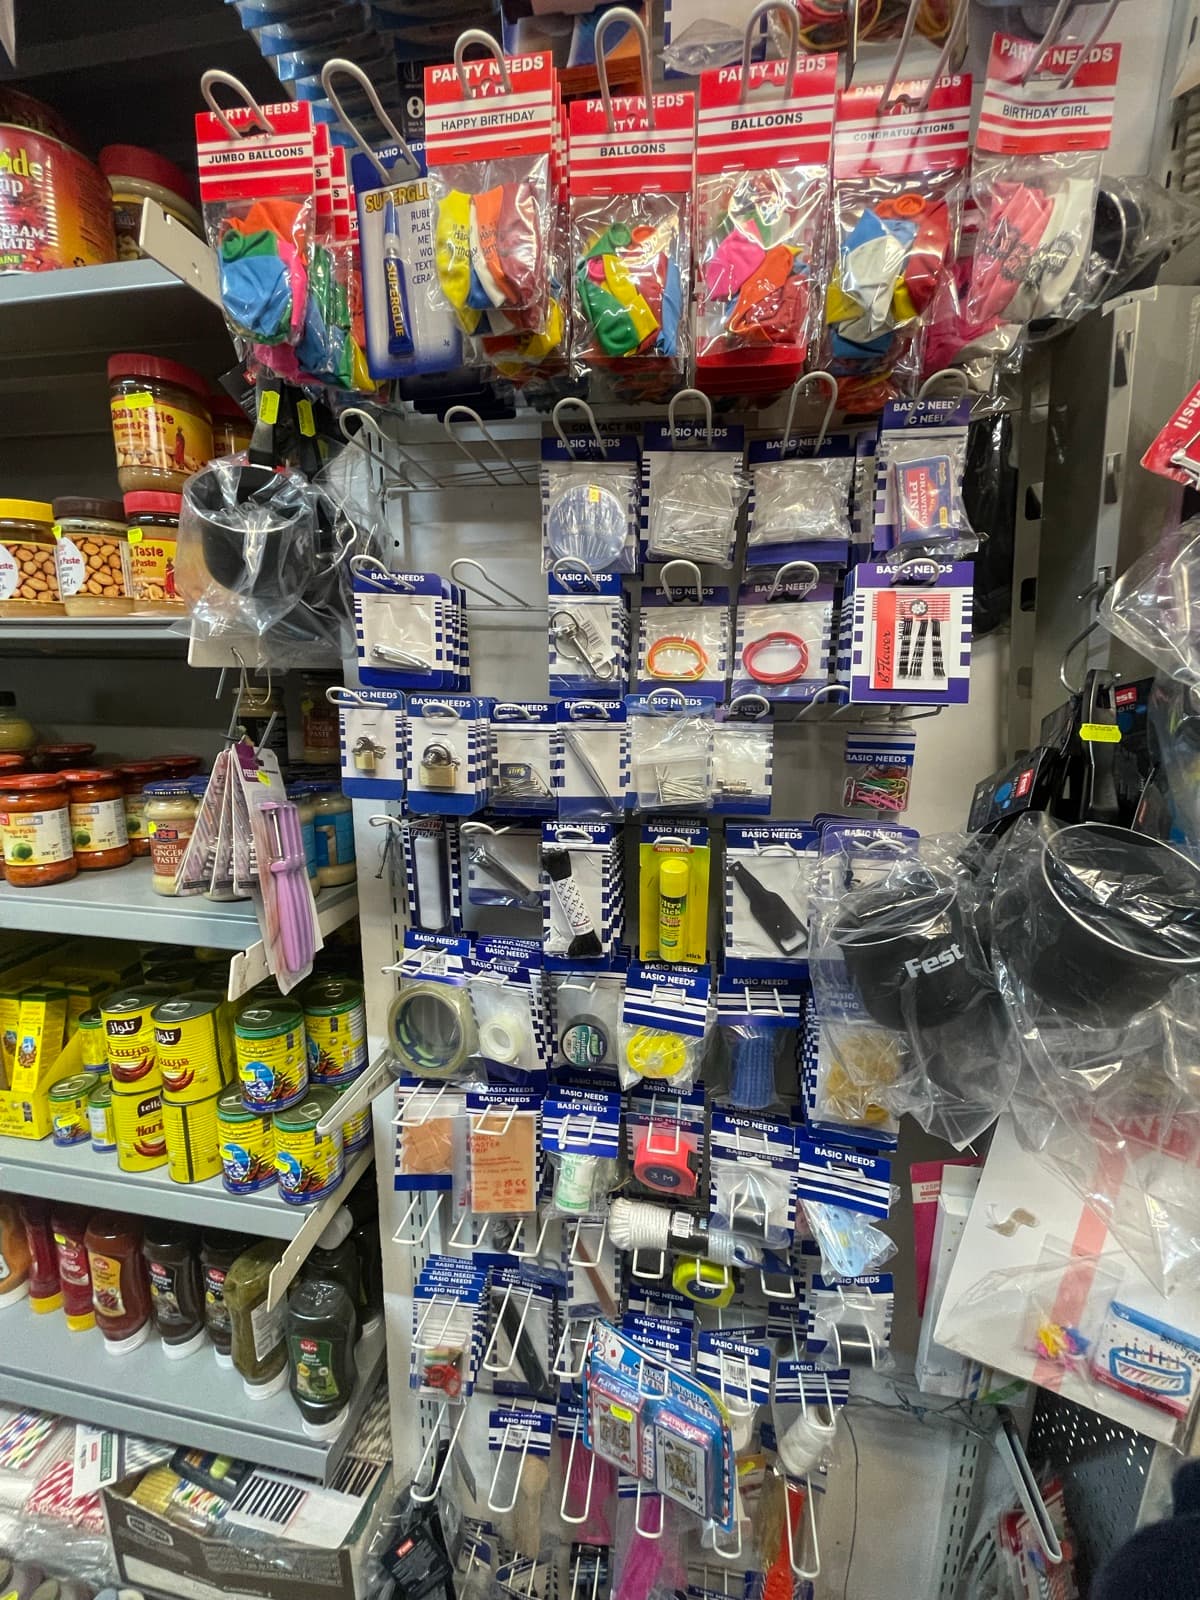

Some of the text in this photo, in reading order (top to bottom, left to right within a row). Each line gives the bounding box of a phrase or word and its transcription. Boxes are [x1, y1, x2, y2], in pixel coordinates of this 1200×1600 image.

[1052, 47, 1113, 65] NEDS
[774, 59, 827, 76] NEDS
[855, 82, 904, 96] PARY
[210, 107, 250, 122] PRTY
[1003, 104, 1090, 119] BIRTHDAY GIRL
[441, 118, 478, 131] HAPPY
[480, 110, 535, 126] BIRTHDAY
[731, 112, 803, 131] BALLOONS
[853, 122, 955, 142] CONGRATULATIONS
[209, 147, 304, 165] JUMBO BALLOONS
[600, 143, 666, 157] BALLOONS
[386, 262, 405, 337] SUPERGLUE
[893, 401, 960, 412] BASC NEED
[908, 481, 920, 521] PINS
[918, 472, 929, 524] DRAWING
[134, 546, 164, 557] Taste
[876, 565, 911, 575] BASC
[398, 574, 425, 582] NEEDS
[754, 583, 783, 593] BASC
[370, 691, 397, 699] NEEDS
[594, 702, 620, 710] EEDS
[671, 698, 702, 706] NEDS
[846, 754, 907, 763] BASIC NEEDS
[546, 824, 606, 833] BASIC NEEDS
[648, 826, 701, 835] BASIC NEEDS
[741, 830, 803, 840] BASIC NEEDS
[153, 849, 184, 857] GINGER
[156, 856, 180, 864] PASTE
[415, 934, 459, 946] BASIC NEEDS
[485, 946, 505, 956] BASIC
[507, 949, 529, 959] NEEDS
[471, 960, 518, 974] BASIC NEEDS
[904, 943, 965, 979] Fest
[672, 965, 698, 973] NEEDS
[640, 972, 696, 987] BASIC NEEDS
[758, 978, 789, 986] NEEDS
[560, 1088, 609, 1102] BASIC NEEDS
[643, 1084, 692, 1097] BASIC NEEDS
[557, 1103, 608, 1114] BASIC NEEDS
[725, 1116, 780, 1133] BASIC NEEDS
[726, 1148, 784, 1162] BASIC NEEDS
[814, 1147, 876, 1168] BASIC NEEDS
[662, 1174, 674, 1182] M
[454, 1263, 477, 1271] NEEDS
[429, 1275, 472, 1285] BASIC NEEDS
[501, 1277, 520, 1285] BASIC
[854, 1276, 880, 1284] NEEDS
[444, 1288, 469, 1296] NEEDS
[639, 1288, 684, 1302] BASIC NEEDS
[634, 1318, 680, 1334] BASIC NEEDS
[632, 1334, 680, 1351] BASIC NEEDS
[710, 1338, 760, 1356] BASIC NEEDS
[790, 1364, 813, 1372] BASIC
[499, 1416, 541, 1427] BASIC NEEDS
